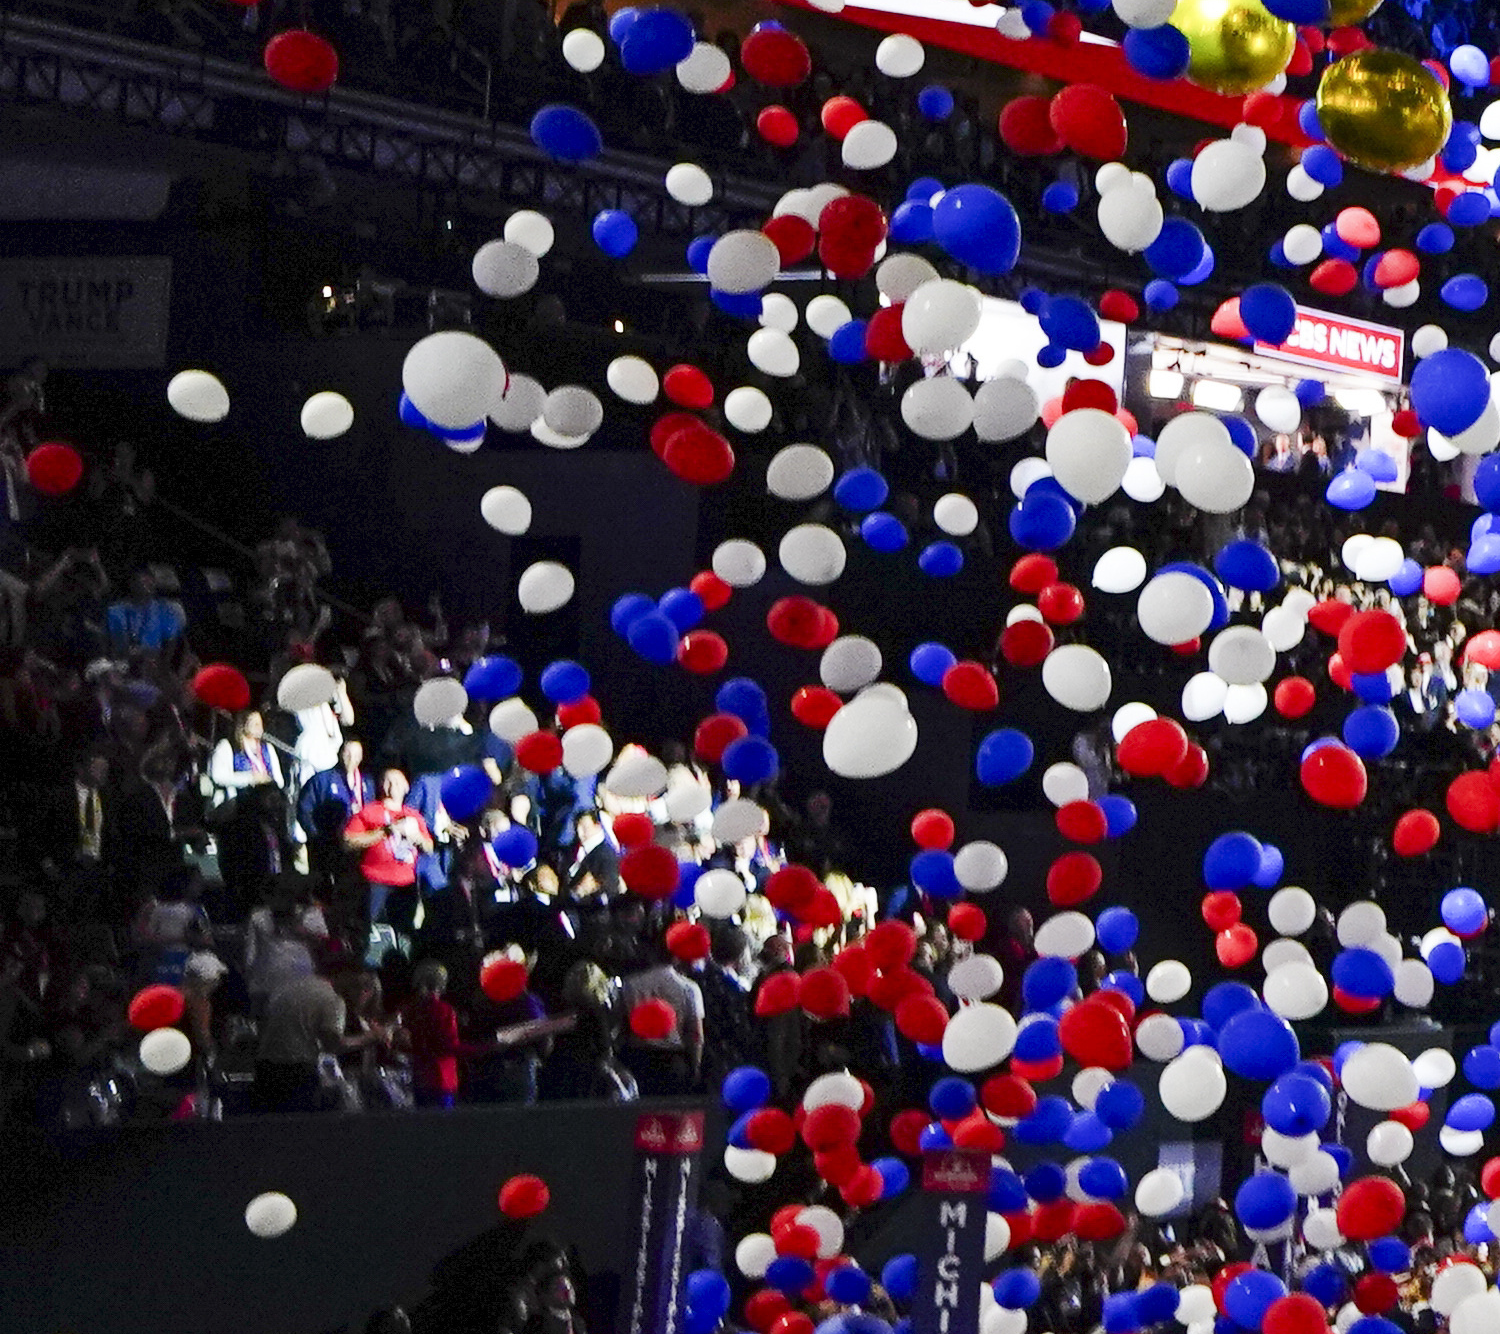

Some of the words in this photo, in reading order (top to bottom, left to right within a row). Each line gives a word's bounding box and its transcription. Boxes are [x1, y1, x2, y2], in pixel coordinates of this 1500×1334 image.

[16, 281, 137, 305] TRUMP
[29, 310, 125, 333] VANCE
[1329, 326, 1397, 368] NEWS
